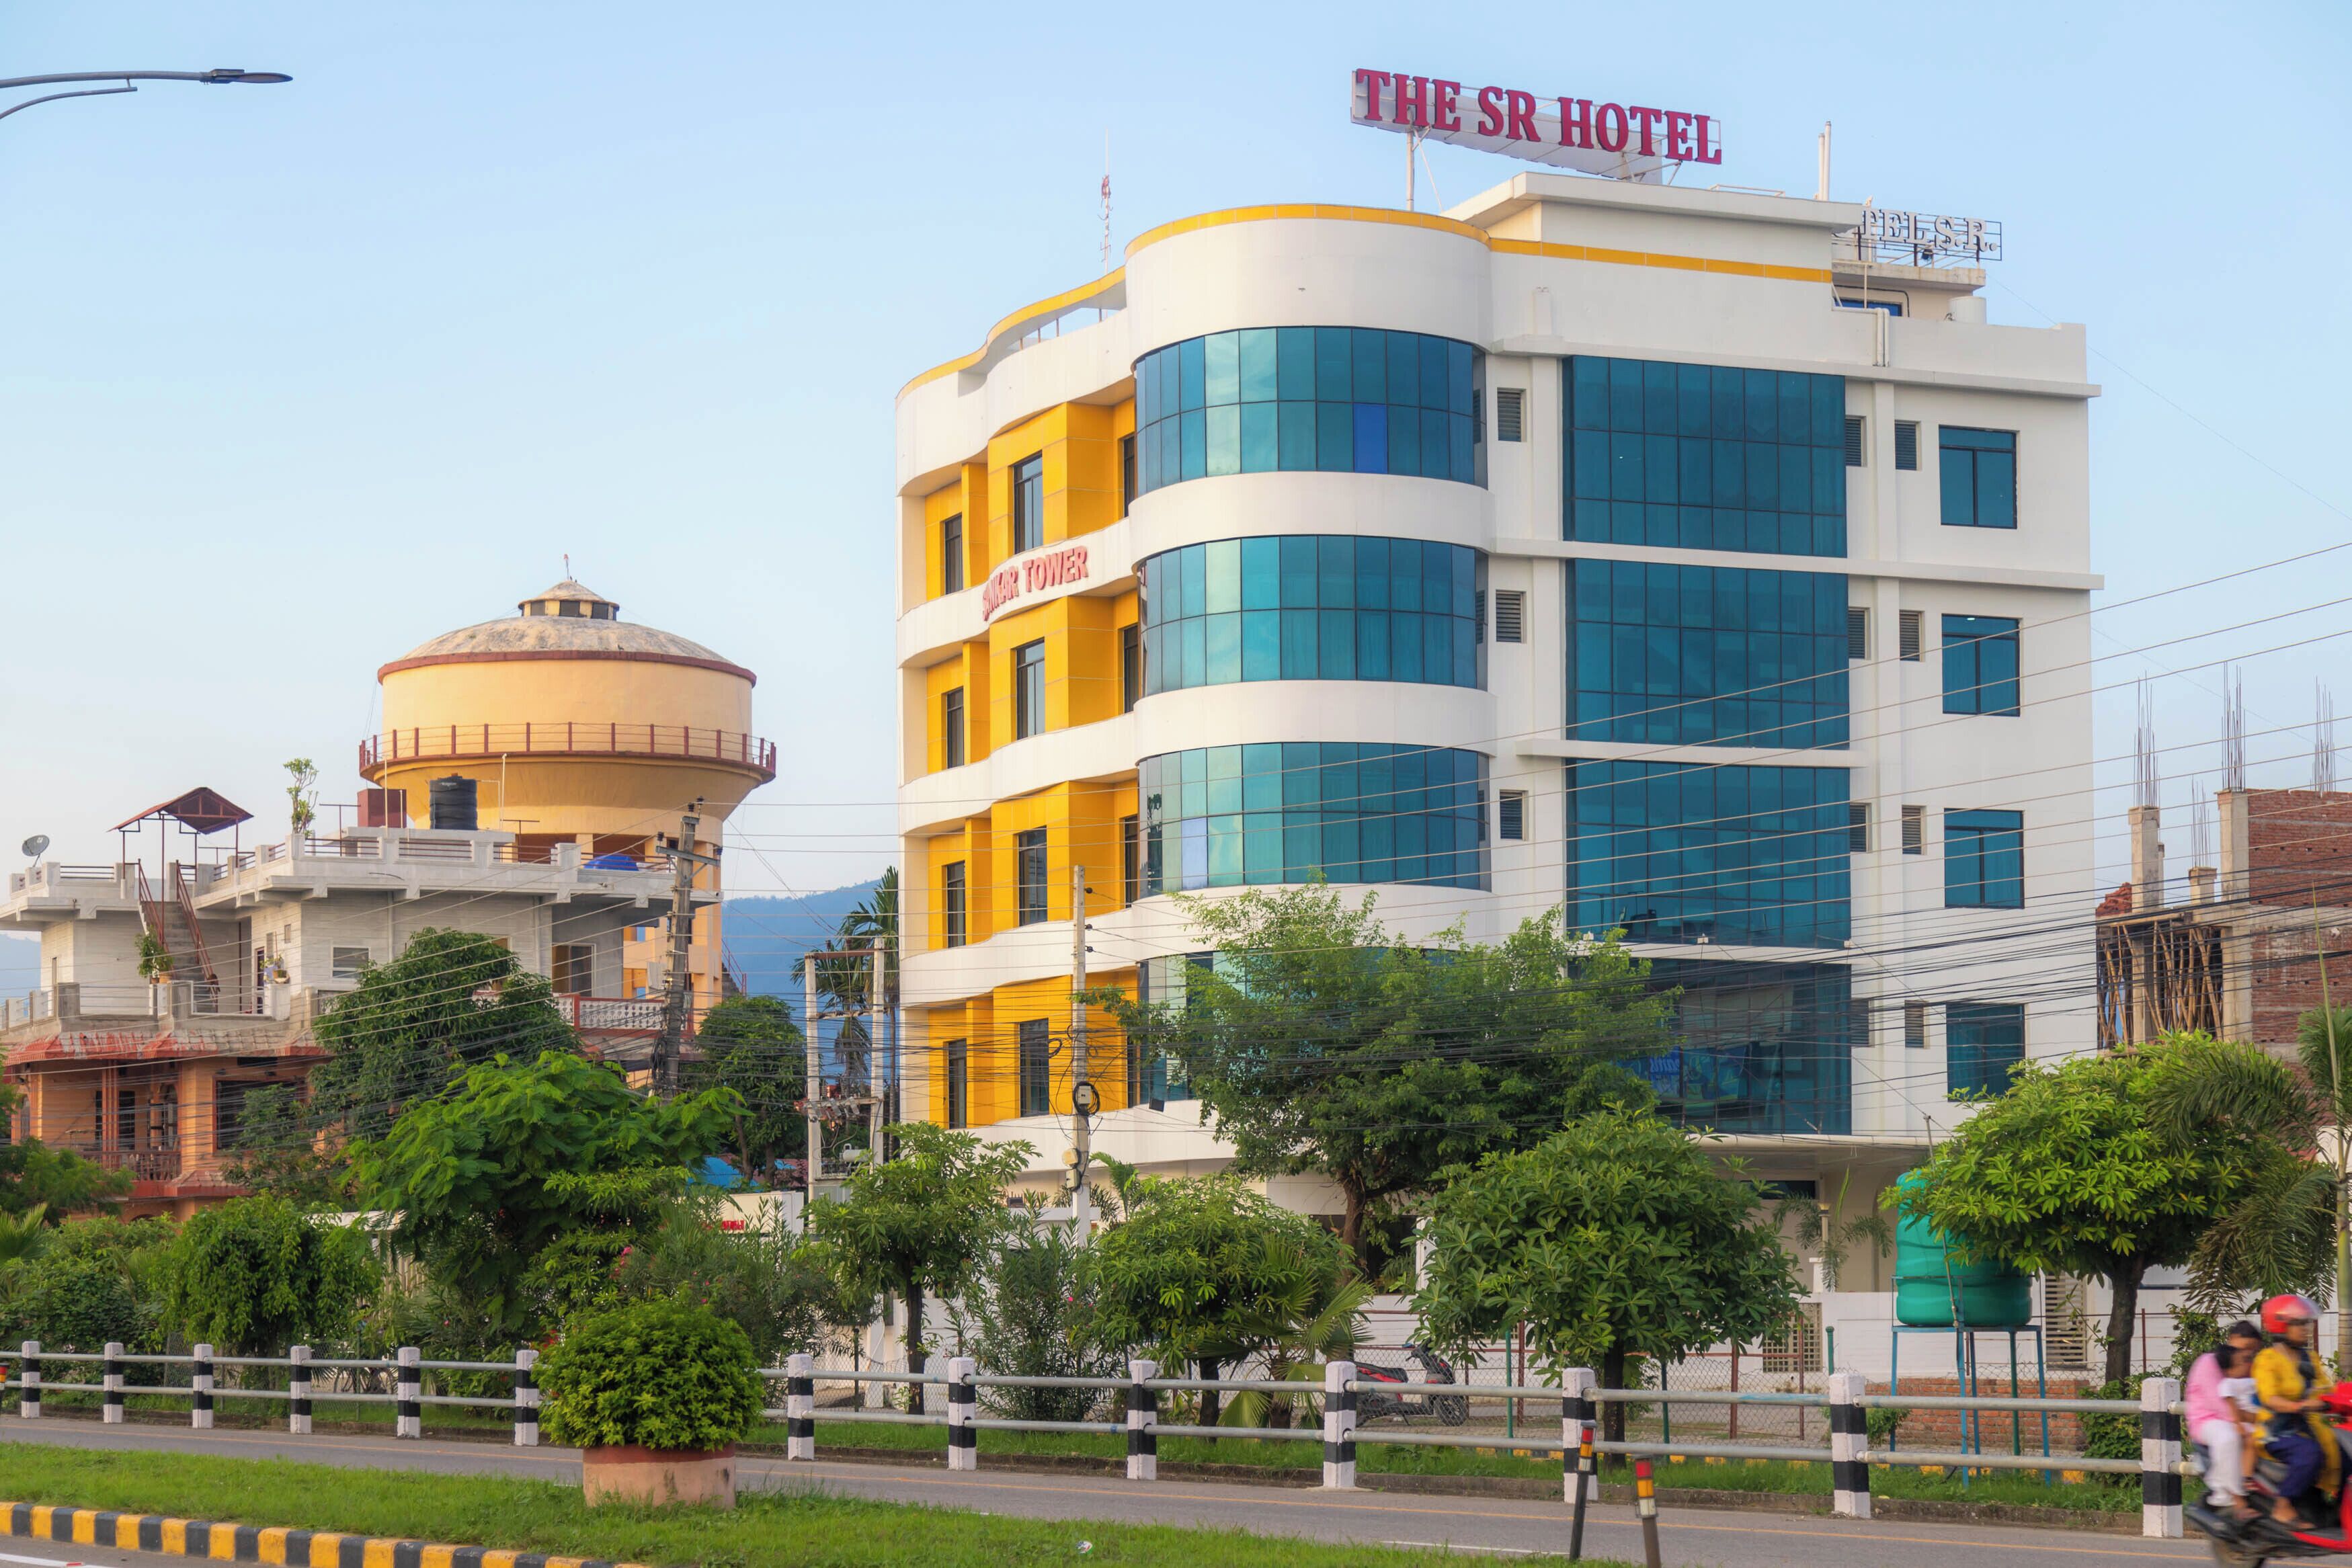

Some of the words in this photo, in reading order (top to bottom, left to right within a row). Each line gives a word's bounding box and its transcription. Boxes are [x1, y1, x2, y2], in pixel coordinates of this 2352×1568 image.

[1356, 68, 1461, 131] THE
[1477, 86, 1541, 142] SR
[1557, 97, 1721, 165] HOTEL
[1022, 546, 1088, 593] TOWER
